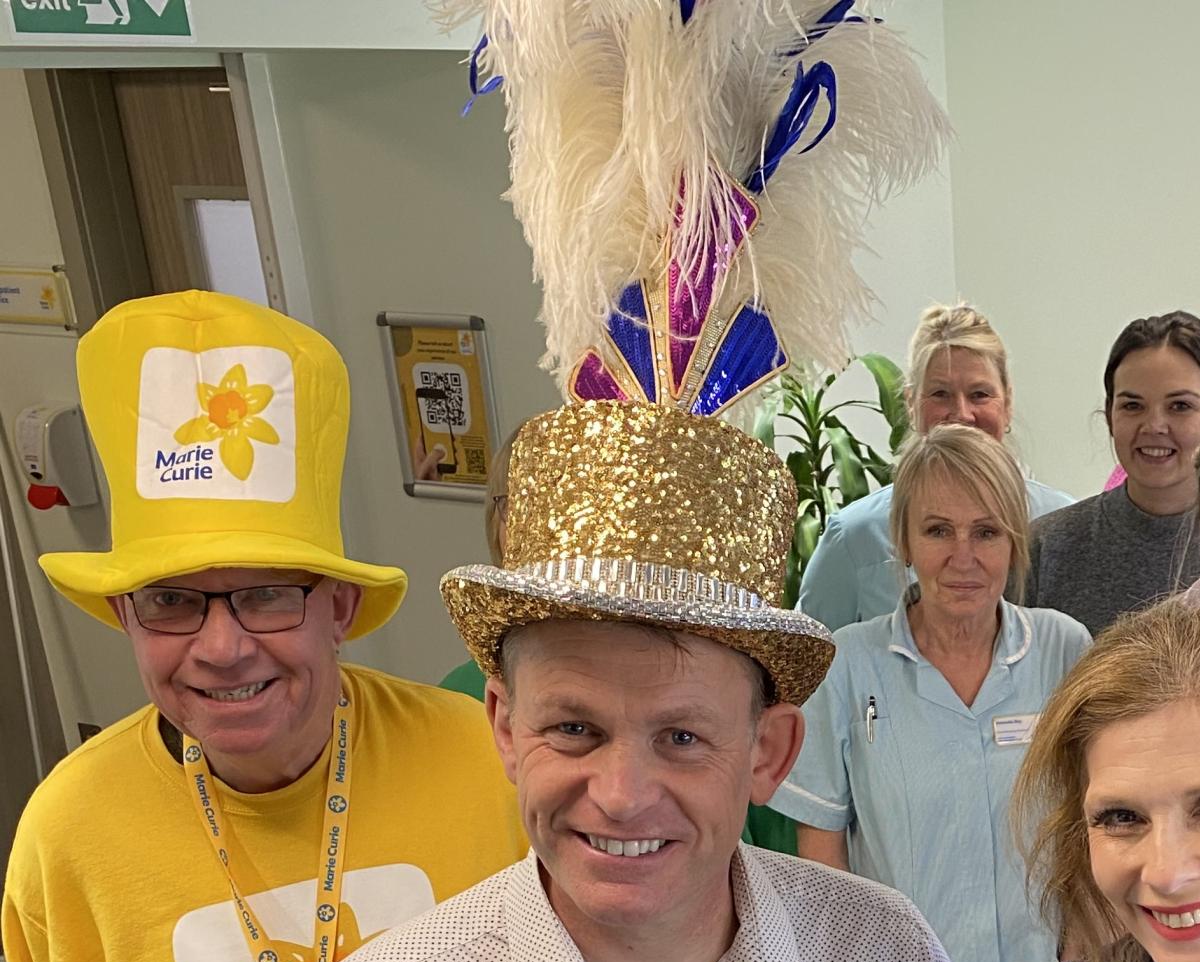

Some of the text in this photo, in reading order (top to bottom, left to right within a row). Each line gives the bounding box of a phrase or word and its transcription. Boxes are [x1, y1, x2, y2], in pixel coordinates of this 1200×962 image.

[155, 445, 213, 469] Marie
[160, 462, 213, 482] Curie
[336, 719, 347, 783] Marie Curie
[194, 773, 220, 836] Marie Curie
[324, 825, 341, 892] Marie Curie
[242, 911, 259, 941] Curie
